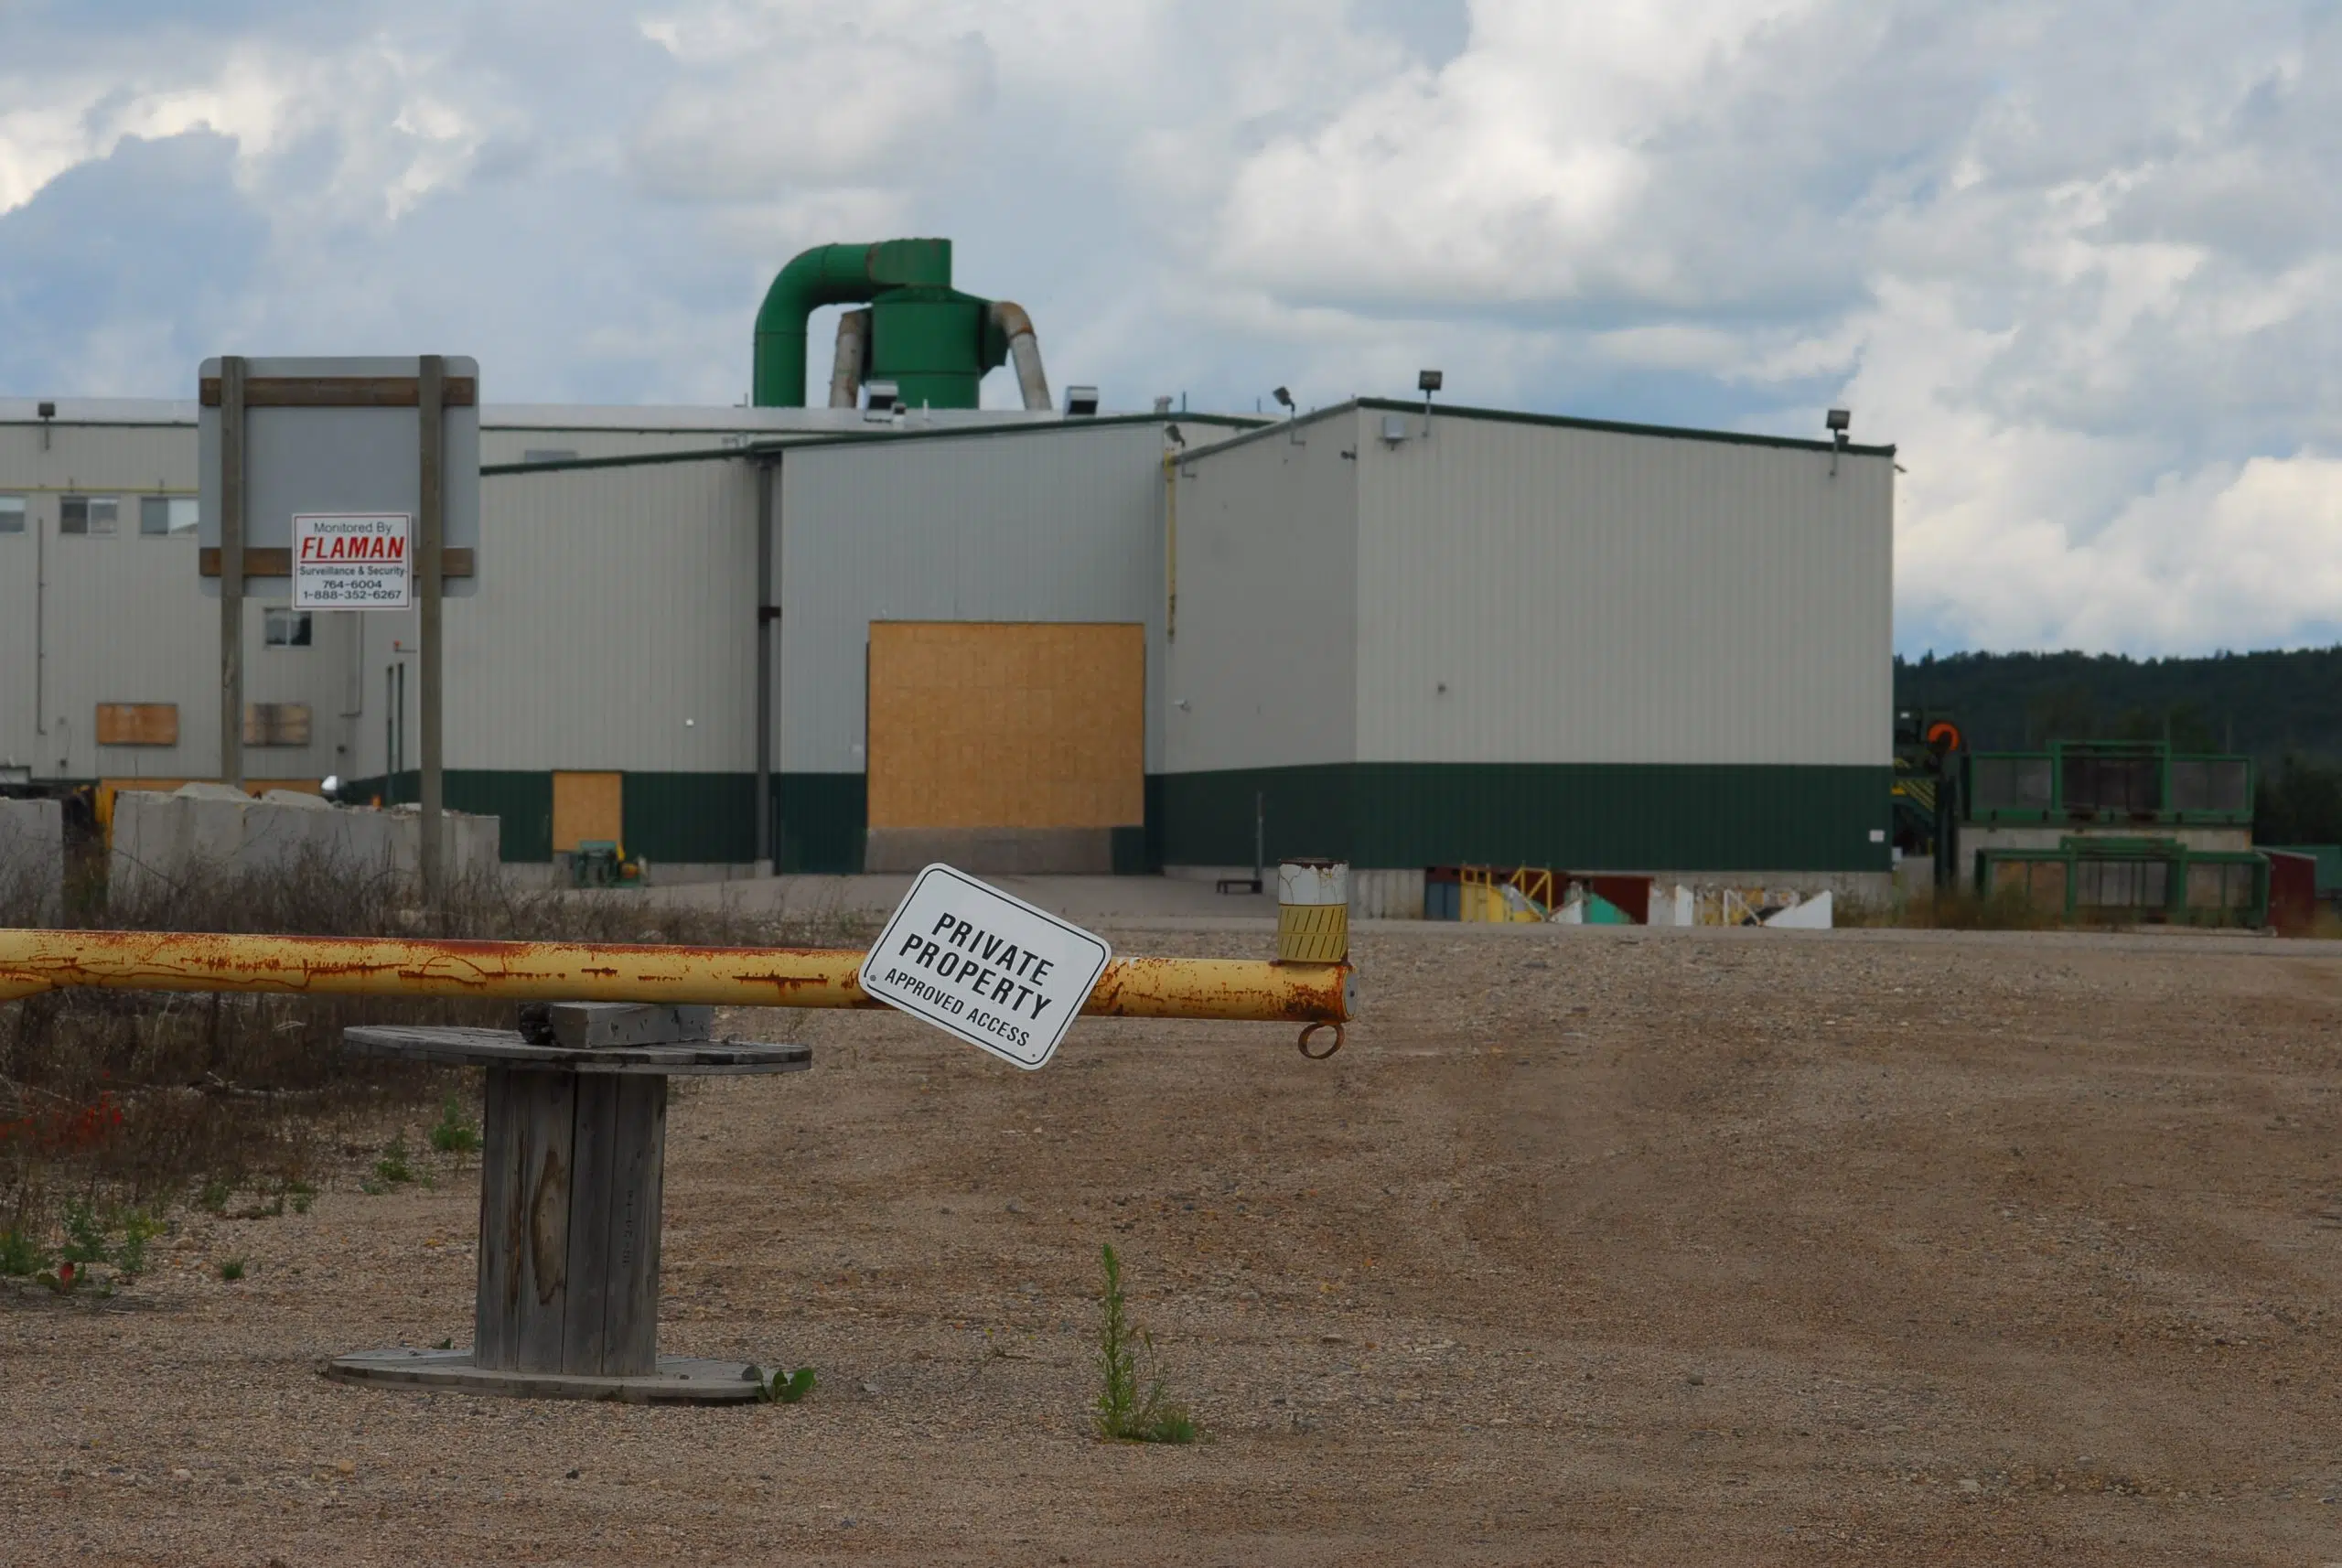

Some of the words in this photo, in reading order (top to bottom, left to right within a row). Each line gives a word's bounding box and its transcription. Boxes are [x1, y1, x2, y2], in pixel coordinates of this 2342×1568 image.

[314, 522, 373, 533] Monitored
[376, 521, 392, 535] By
[300, 536, 405, 559] FLAMAN
[299, 565, 356, 576] Surveillance
[358, 565, 365, 576] &
[367, 565, 405, 578] Security
[322, 579, 382, 589] 764-6004
[304, 590, 403, 600] 1-888-352-6267
[931, 912, 1055, 987] PRIVATE
[898, 933, 1052, 1021] PROPERTY
[885, 968, 965, 1015] APPROVED
[966, 1007, 1030, 1047] ACCESS
